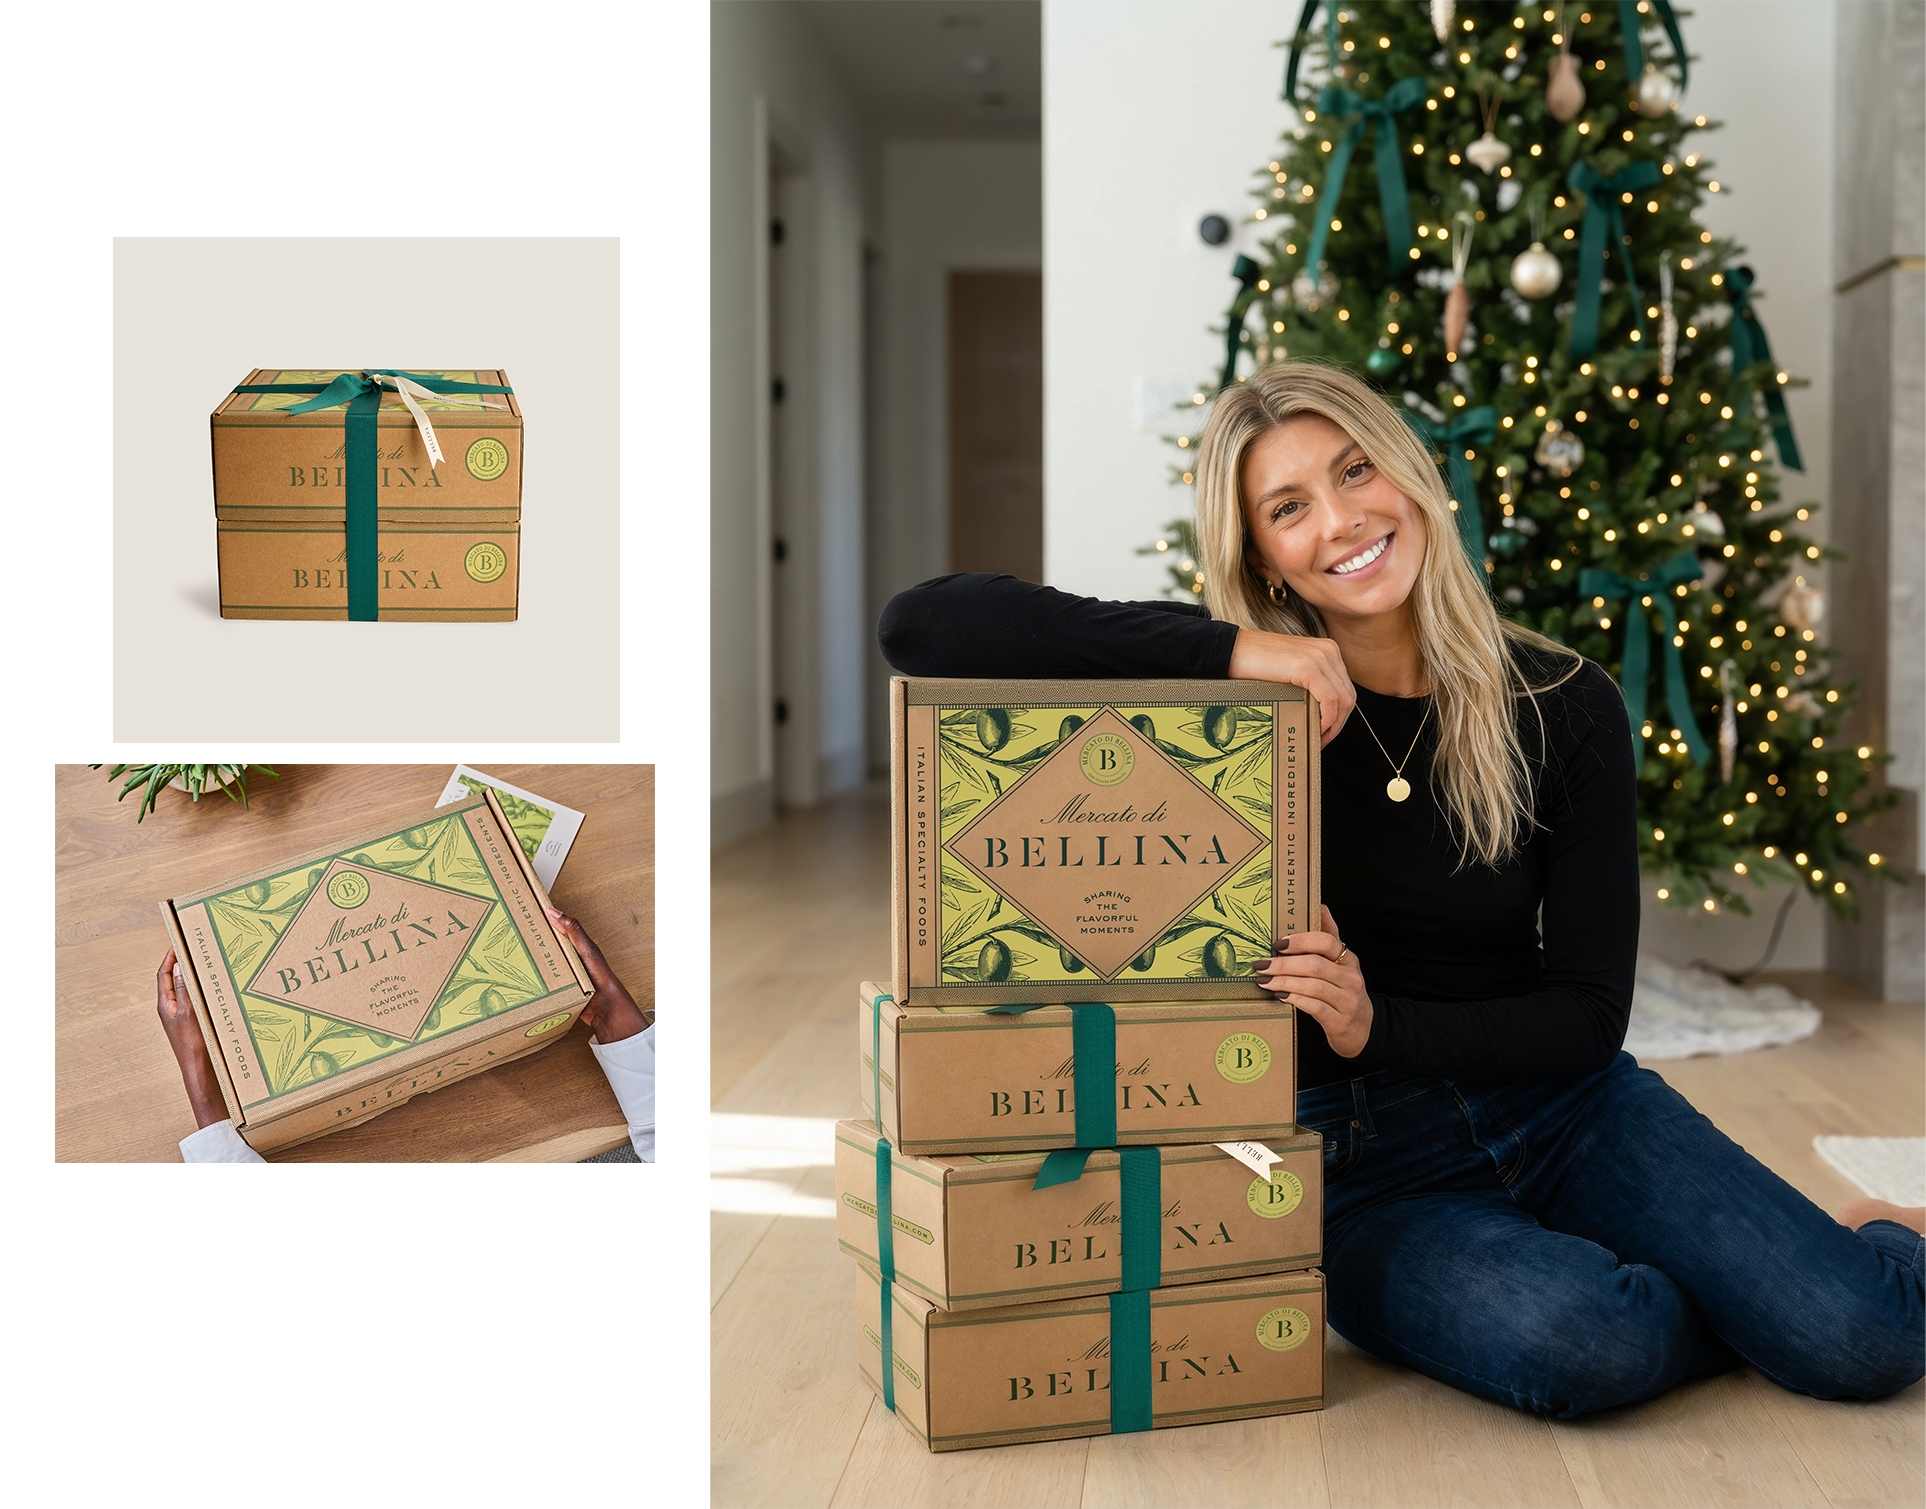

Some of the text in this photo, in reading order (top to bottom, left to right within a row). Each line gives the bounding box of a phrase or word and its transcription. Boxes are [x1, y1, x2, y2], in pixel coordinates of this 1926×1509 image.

[387, 445, 404, 460] di
[481, 451, 494, 468] B
[289, 466, 443, 488] BELINA
[388, 549, 405, 563] di
[479, 554, 492, 571] B
[293, 569, 442, 589] BELINA
[1082, 736, 1103, 766] MERCATO
[1115, 738, 1132, 765] BELLINA
[1099, 748, 1117, 770] B
[1287, 726, 1296, 825] INGREDIENTS
[1040, 793, 1168, 825] Mercato di
[476, 817, 513, 884] INGREDIENTS
[917, 746, 927, 947] ITALIAN SPECIALTY FOODS
[983, 834, 1230, 868] BELLINA
[1287, 832, 1296, 916] AUTHENTIC
[341, 882, 356, 899] B
[1083, 890, 1132, 904] SHARING
[512, 888, 546, 948] AUTHENTIC
[1096, 903, 1118, 911] THE
[315, 902, 410, 951] Mercato di
[1076, 915, 1139, 923] FLAVORFUL
[1080, 927, 1135, 935] MOMENTS
[275, 910, 471, 995] BELLINA
[543, 952, 561, 979] FINE
[370, 975, 407, 993] SHARING
[381, 985, 399, 994] THE
[194, 927, 250, 1080] ITALIAN SPECIALTY FOODS
[369, 988, 419, 1009] FLAVORFUL
[376, 998, 419, 1017] MOMENTS
[1217, 1036, 1239, 1065] MERCATO
[1251, 1036, 1269, 1063] BELLINA
[1235, 1047, 1253, 1069] B
[1127, 1057, 1150, 1076] di
[989, 1083, 1203, 1117] BELINA
[1249, 1176, 1266, 1202] MERCAT
[1283, 1173, 1301, 1198] BELLINA
[1267, 1183, 1285, 1205] B
[1160, 1199, 1181, 1219] di
[1012, 1221, 1235, 1269] BELNA
[1258, 1310, 1280, 1337] MERCATO
[1276, 1320, 1293, 1339] B
[1165, 1334, 1189, 1352] di
[1007, 1353, 1243, 1402] BELINA
